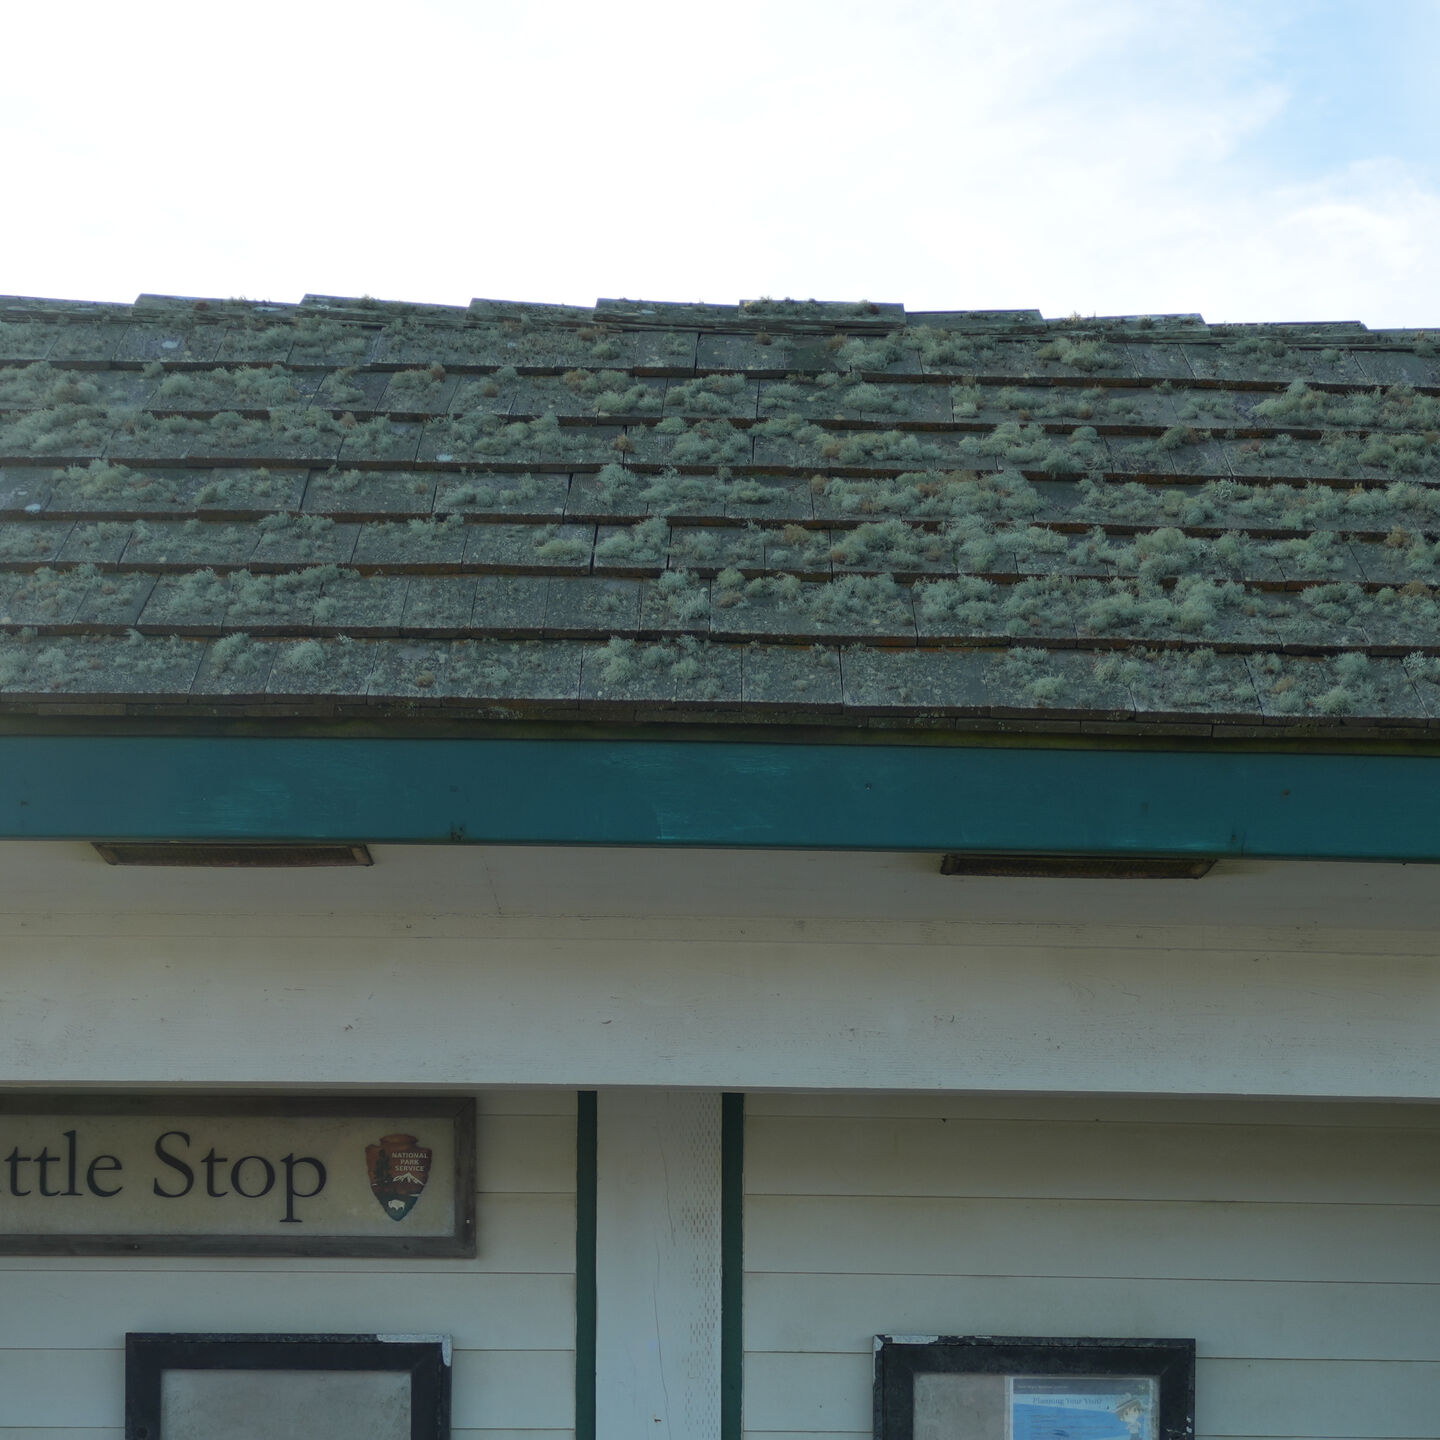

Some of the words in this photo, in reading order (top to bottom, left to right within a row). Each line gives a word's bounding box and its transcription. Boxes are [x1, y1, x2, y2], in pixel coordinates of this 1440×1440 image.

[391, 1151, 428, 1159] NATIONAL
[152, 1130, 328, 1224] Stop
[1032, 1397, 1064, 1407] Planning
